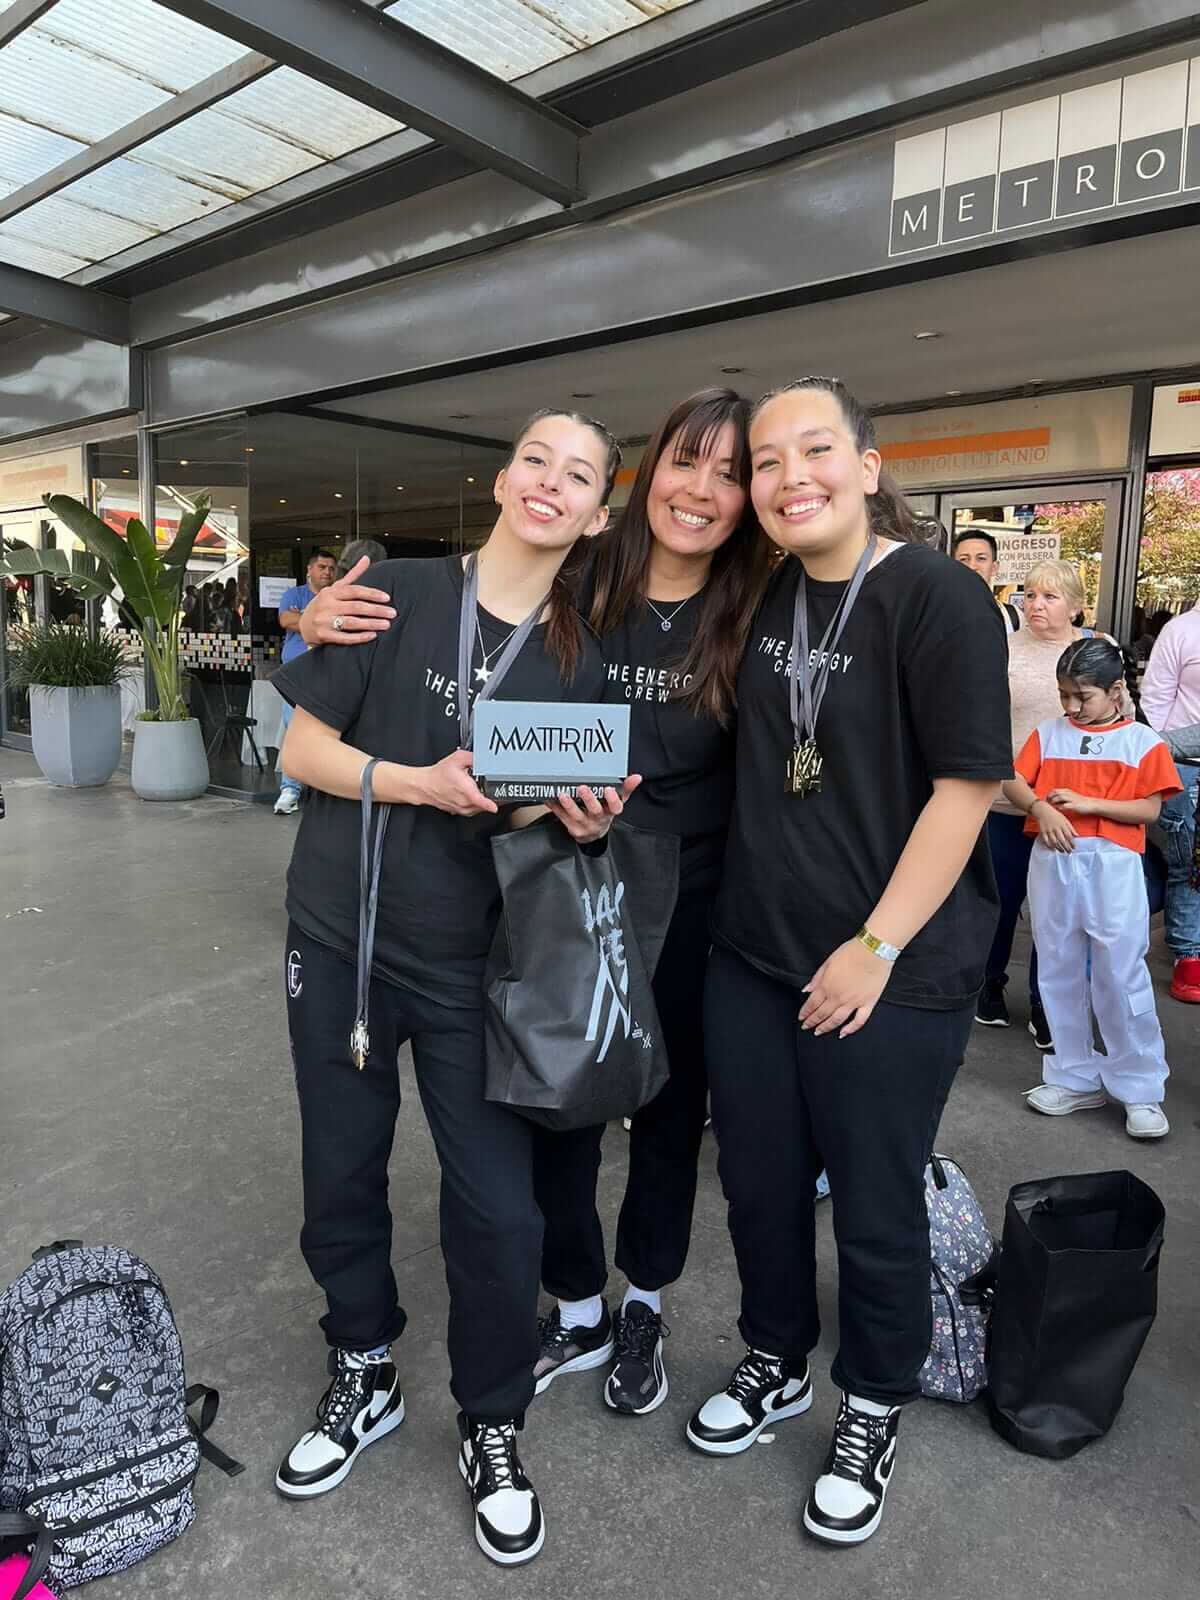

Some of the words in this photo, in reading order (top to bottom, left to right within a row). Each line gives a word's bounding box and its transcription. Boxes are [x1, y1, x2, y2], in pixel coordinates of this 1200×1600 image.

[902, 149, 1166, 235] METRO
[998, 538, 1057, 551] INGRESO
[1000, 552, 1015, 561] CON
[1017, 551, 1055, 560] PULSERA
[1010, 562, 1031, 570] PUES
[758, 636, 787, 657] THE
[425, 668, 458, 699] THE
[625, 685, 670, 703] CREW
[508, 784, 555, 798] SELECTIVA
